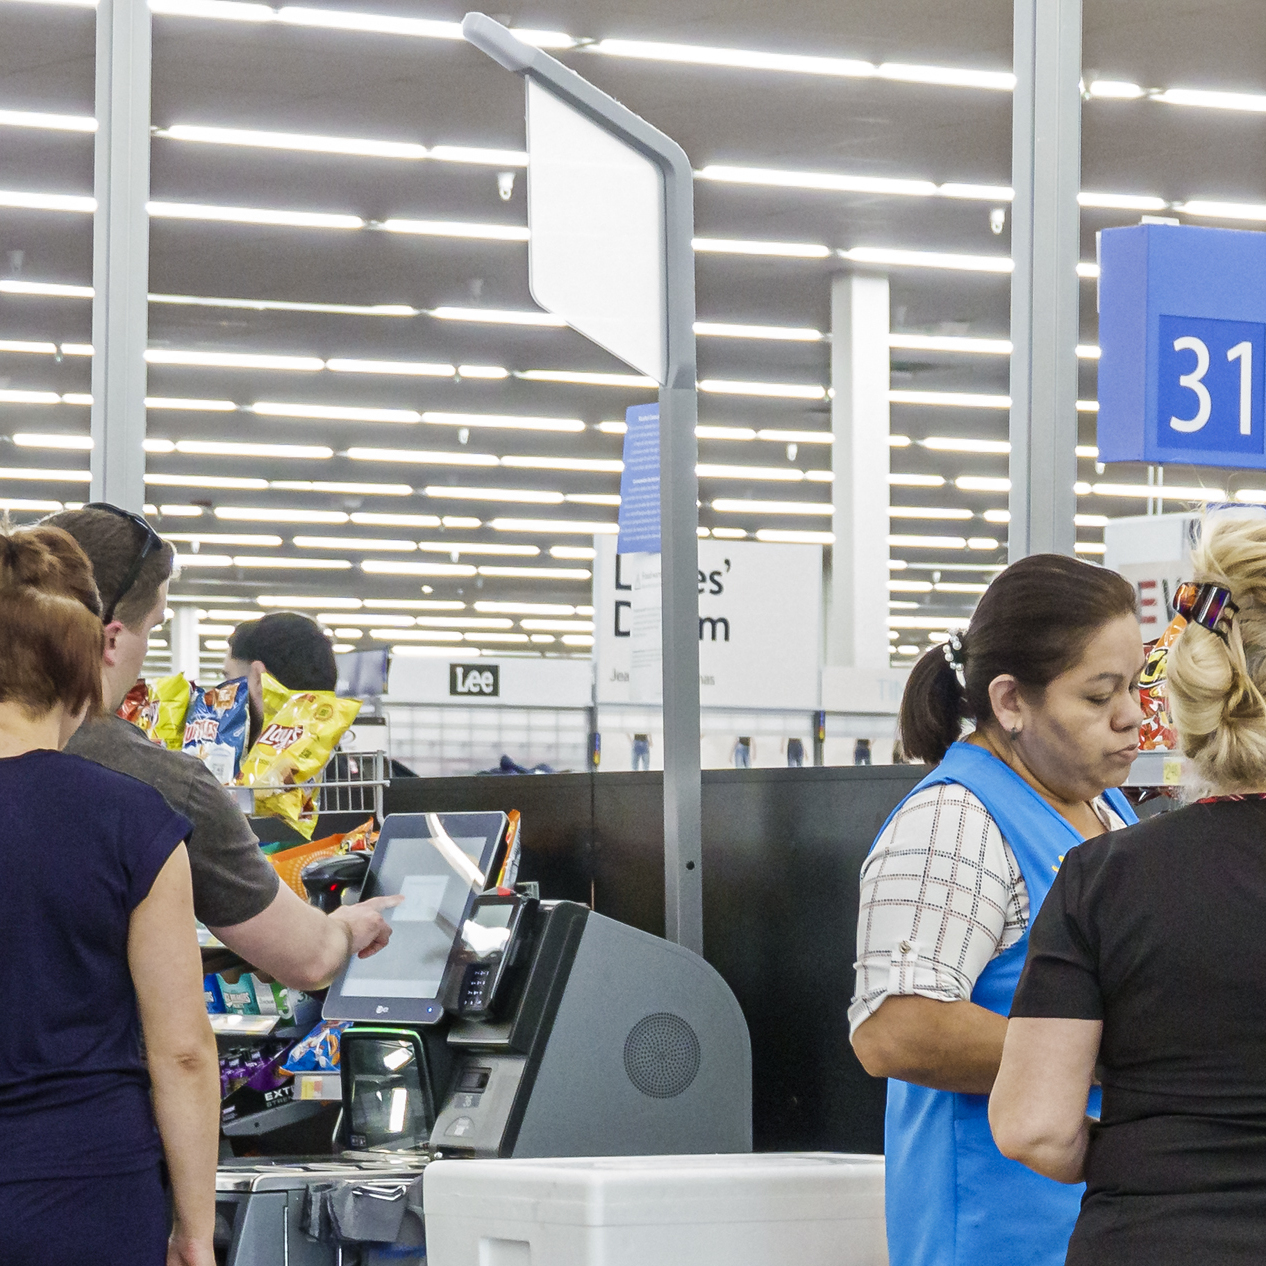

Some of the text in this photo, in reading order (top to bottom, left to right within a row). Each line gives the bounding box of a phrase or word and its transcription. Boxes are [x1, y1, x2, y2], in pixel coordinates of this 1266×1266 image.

[1170, 336, 1252, 435] 31
[615, 554, 731, 595] Les'
[455, 666, 494, 694] Lee
[260, 723, 304, 750] Lay's
